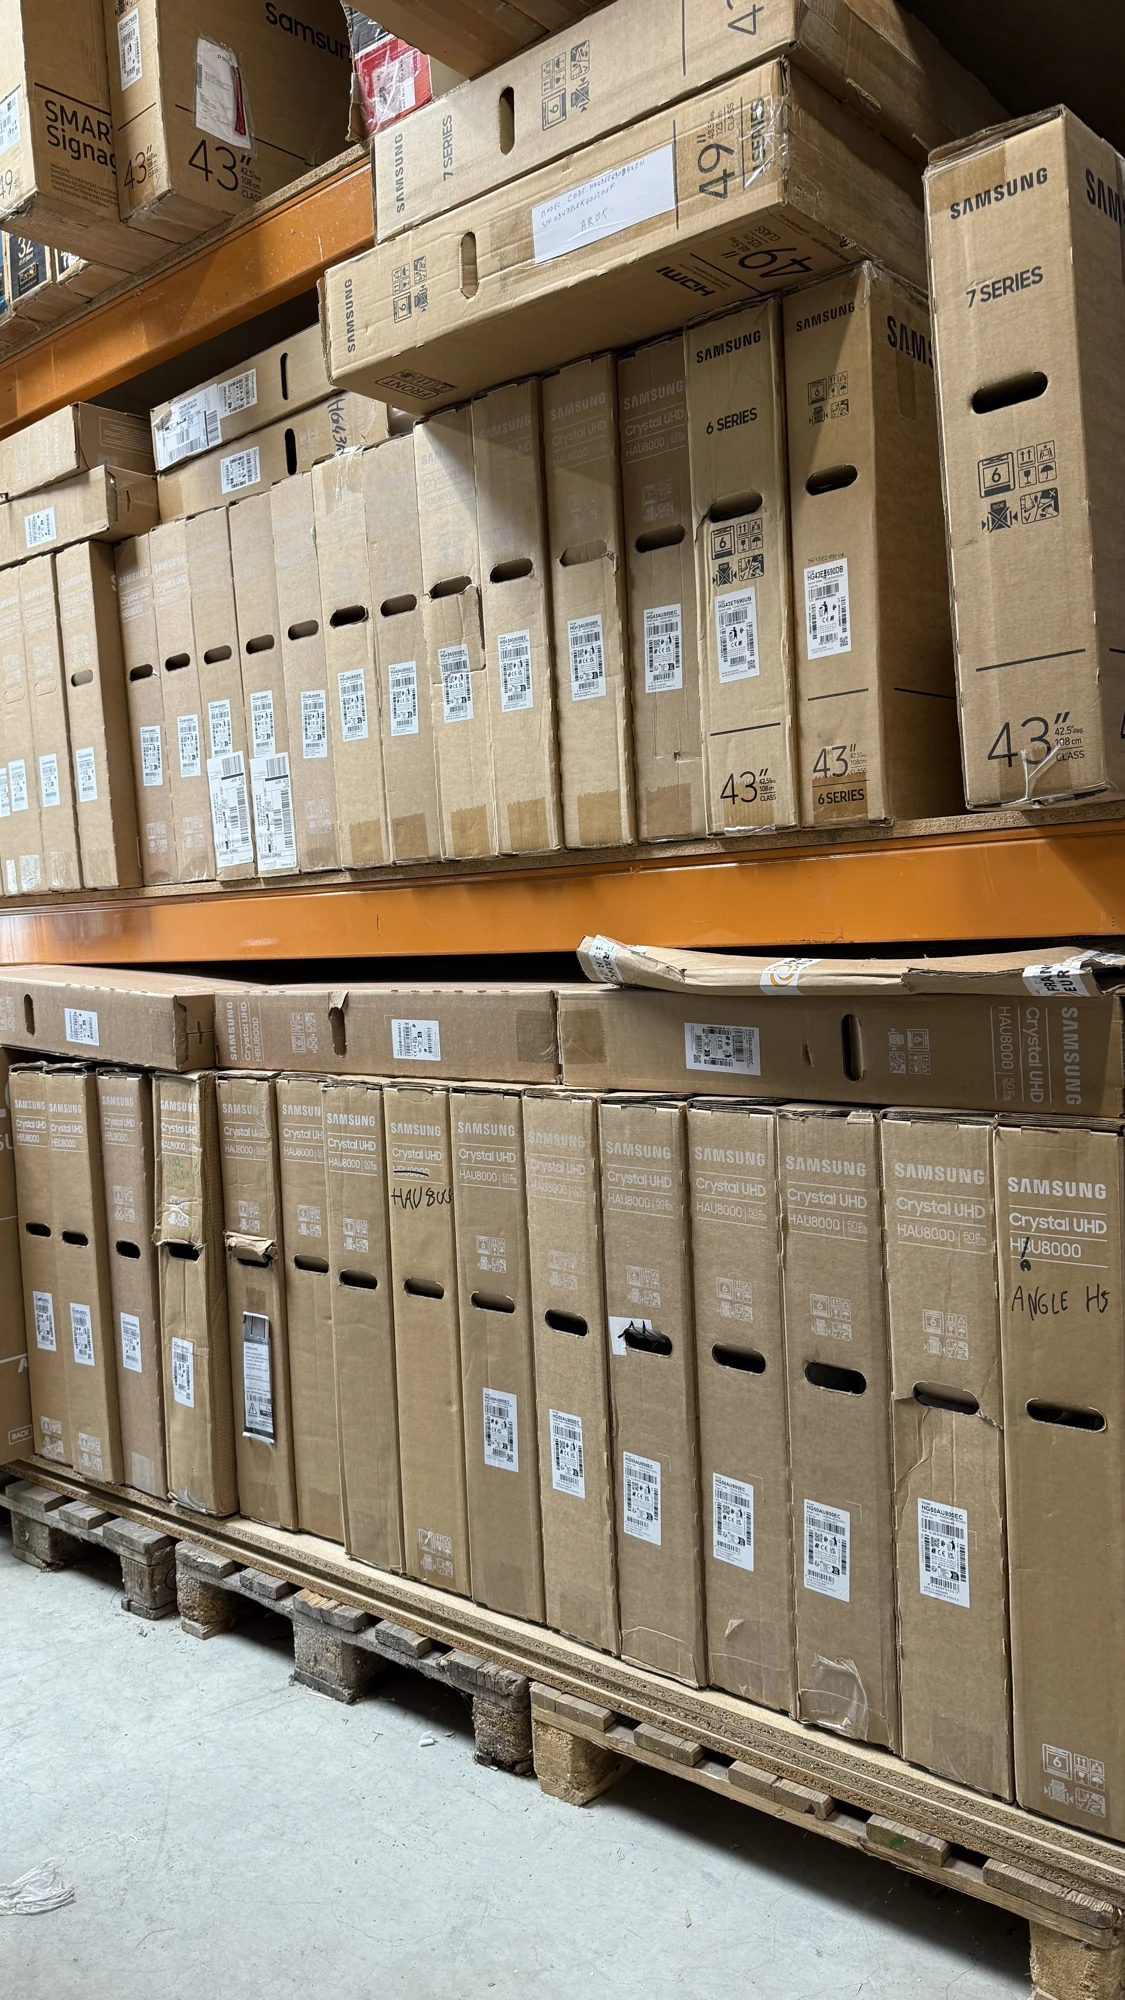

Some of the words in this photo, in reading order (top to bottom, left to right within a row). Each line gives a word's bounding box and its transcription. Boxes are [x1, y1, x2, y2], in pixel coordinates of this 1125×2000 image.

[727, 0, 764, 37] 4
[265, 2, 351, 59] Samsun
[44, 99, 113, 145] SMAR
[442, 115, 453, 169] SERIES
[395, 133, 405, 214] SAMSUNG
[442, 171, 453, 182] 7
[949, 167, 1049, 220] SAMSUNG
[1085, 168, 1125, 226] SAM
[655, 266, 716, 296] HDMI
[966, 288, 978, 308] 7
[980, 266, 1044, 304] SERIES
[344, 278, 356, 354] SAMSUNG
[796, 302, 855, 332] SAMSUNG
[695, 330, 762, 364] SAMSUNG
[382, 379, 432, 398] FRONT
[624, 380, 684, 410] SAMSUNG
[550, 392, 606, 421] SAMSUNG
[625, 416, 662, 436] Crystal
[664, 409, 684, 424] UHD
[706, 420, 714, 434] 6
[716, 408, 758, 432] SERIES
[626, 437, 664, 458] HAU8000
[119, 568, 150, 586] SAMSUNG
[988, 712, 1070, 768] 43"
[1055, 738, 1070, 746] 108
[1056, 750, 1084, 762] CLASS
[720, 768, 769, 805] 43"
[818, 793, 825, 805] 6
[826, 788, 865, 804] SERIES
[760, 794, 776, 802] CLASS
[1039, 964, 1059, 992] FRAN
[244, 1002, 252, 1026] UHD
[228, 1002, 238, 1062] SAMSUNG
[254, 1016, 263, 1062] HBU8000
[998, 1006, 1014, 1070] HAU8000
[1022, 1006, 1042, 1066] Crystal
[244, 1028, 253, 1062] Crystal
[1062, 1006, 1082, 1105] SAMSUNG
[1030, 1071, 1044, 1102] UHD
[14, 1100, 46, 1110] SAMSUNG
[48, 1103, 82, 1114] SAMSUNG
[102, 1096, 134, 1108] SAMSUNG
[160, 1100, 198, 1114] SAMSUNG
[282, 1104, 322, 1117] SAMSUN
[326, 1112, 376, 1126] SAMSUNG
[224, 1126, 250, 1139] Crystal
[283, 1128, 310, 1140] Crystal
[311, 1129, 323, 1140] UH
[390, 1122, 441, 1137] SAMSUNG
[458, 1122, 515, 1137] SAMSUNG
[528, 1130, 585, 1148] SAMSUNG
[225, 1144, 253, 1154] HAU8000
[284, 1147, 313, 1157] HAU8000
[328, 1138, 358, 1152] Crystal
[359, 1140, 376, 1151] UHD
[392, 1148, 424, 1161] Crystal
[425, 1150, 442, 1161] UHD
[606, 1141, 671, 1159] SAMSUNG
[328, 1158, 360, 1169] HAU8000
[459, 1149, 494, 1163] Crystal
[497, 1152, 516, 1163] UHD
[694, 1146, 766, 1167] SAMSUNG
[460, 1170, 497, 1182] HAU8000
[531, 1158, 564, 1174] Crystal
[567, 1163, 586, 1175] UHD
[786, 1156, 867, 1177] SAMSUNG
[894, 1162, 985, 1185] SAMSUNG
[532, 1182, 568, 1195] HAU8000
[607, 1170, 648, 1186] Crystal
[650, 1176, 672, 1188] UHD
[696, 1178, 739, 1194] Crystal
[742, 1183, 766, 1197] UHD
[1008, 1177, 1107, 1200] SAMSUNG
[608, 1193, 650, 1208] HAU8000
[787, 1188, 836, 1206] Crystal
[840, 1194, 867, 1208] UHD
[896, 1196, 951, 1216] Crystal
[954, 1203, 986, 1219] UHD
[696, 1201, 742, 1218] HAU8000
[788, 1212, 840, 1231] HAU8000
[1009, 1212, 1069, 1232] Crystal
[1073, 1218, 1108, 1235] UHD
[897, 1223, 955, 1242] HAU8000
[1012, 1285, 1068, 1321] ANGLE
[12, 1429, 29, 1440] BACK
